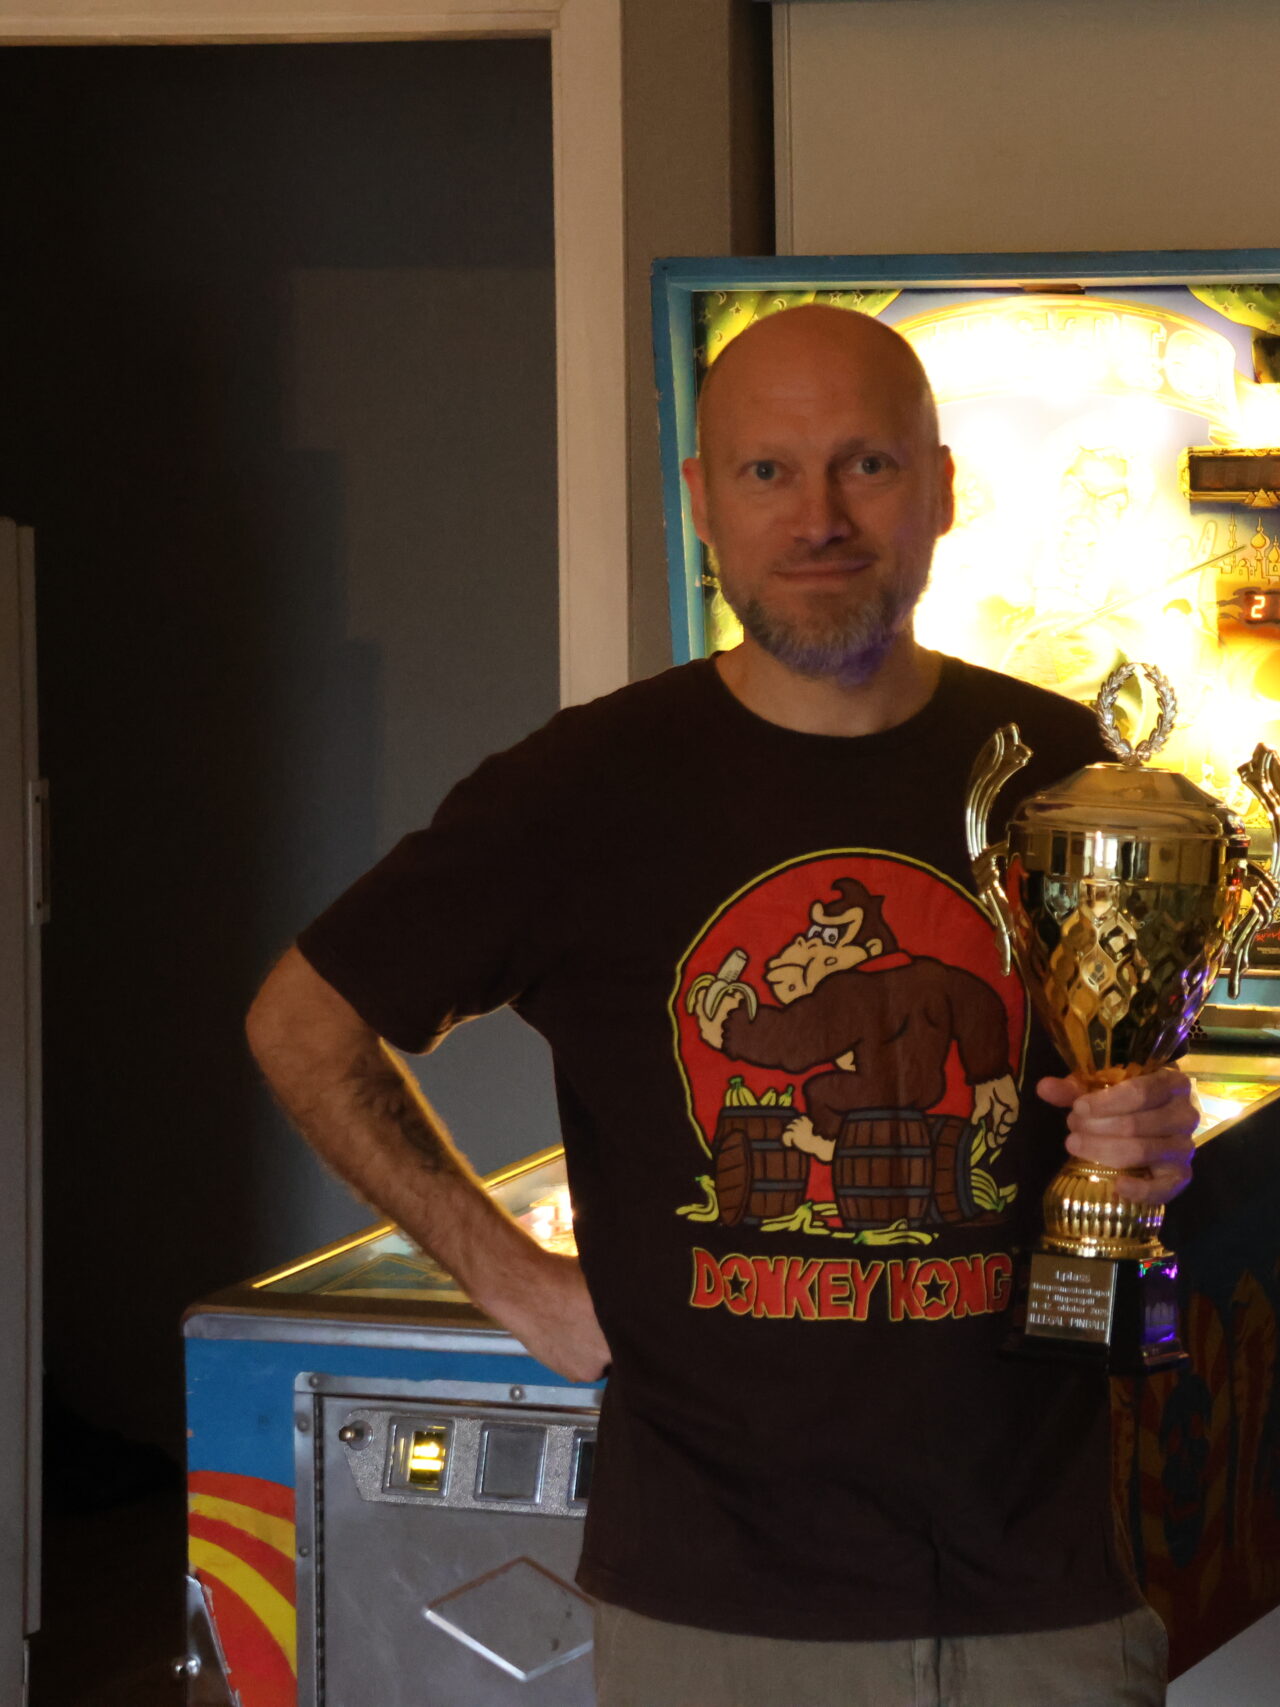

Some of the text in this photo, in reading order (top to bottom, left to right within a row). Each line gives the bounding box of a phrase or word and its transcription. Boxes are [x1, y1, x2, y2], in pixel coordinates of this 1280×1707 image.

[689, 1246, 1013, 1321] DONKEY KONG
[1030, 1313, 1105, 1330] ILLEGAL PINBALL
